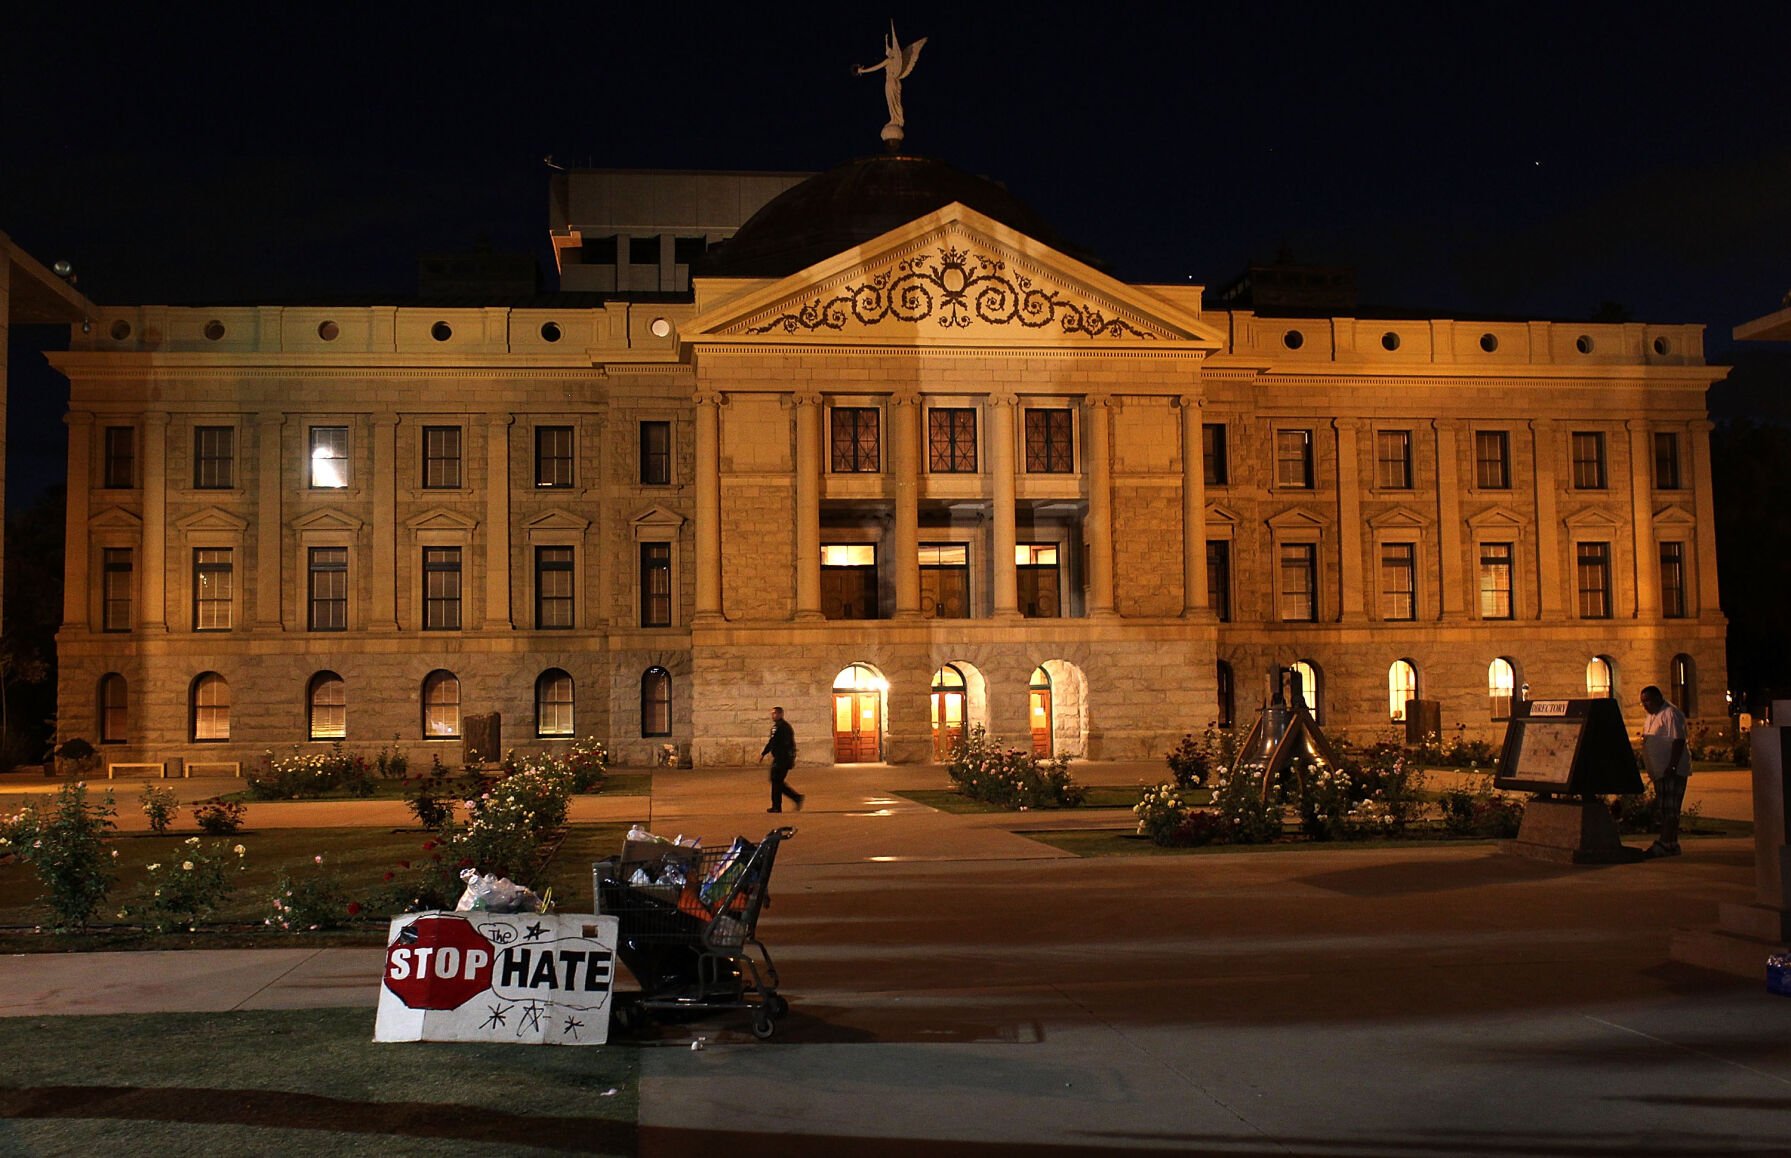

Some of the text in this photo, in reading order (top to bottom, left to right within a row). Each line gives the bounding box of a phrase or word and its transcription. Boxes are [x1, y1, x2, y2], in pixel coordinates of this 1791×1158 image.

[1531, 703, 1566, 713] DIRECTORY
[490, 929, 511, 943] The
[390, 947, 610, 992] STOP HATE
